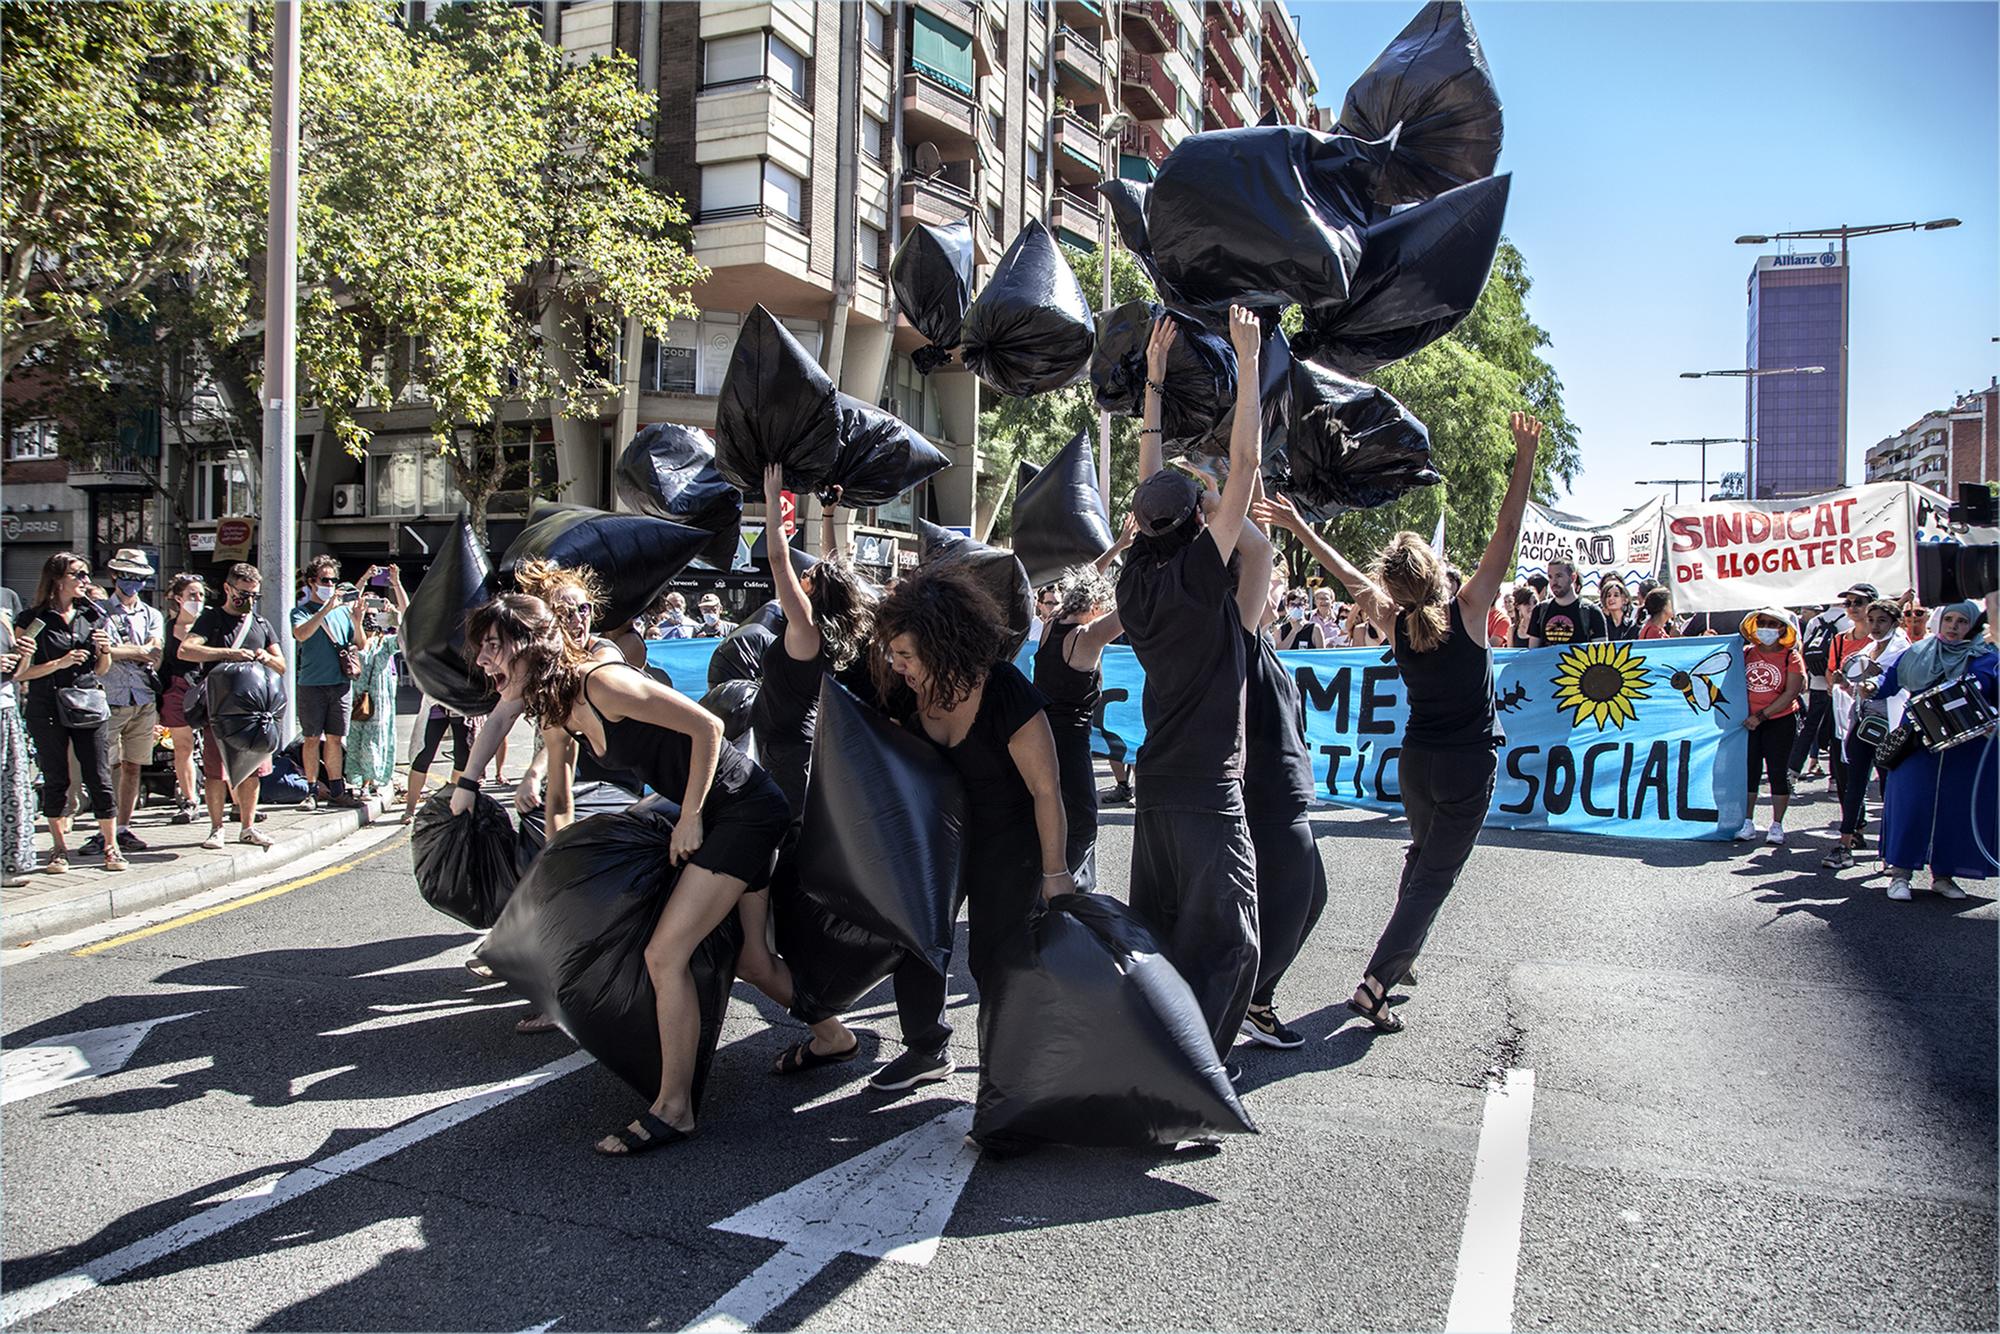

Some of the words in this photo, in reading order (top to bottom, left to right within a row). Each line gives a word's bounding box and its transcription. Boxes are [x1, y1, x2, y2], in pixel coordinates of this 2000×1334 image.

[1773, 254, 1817, 267] Allianz
[662, 347, 691, 358] CODE
[1669, 497, 1857, 553] SINDICAT
[1519, 545, 1574, 561] ACIONS
[1576, 535, 1615, 564] NO
[1630, 533, 1649, 545] NUS
[1676, 562, 1703, 583] DE
[1717, 530, 1896, 579] LLOGATERES
[1500, 740, 1719, 822] SOCIAL
